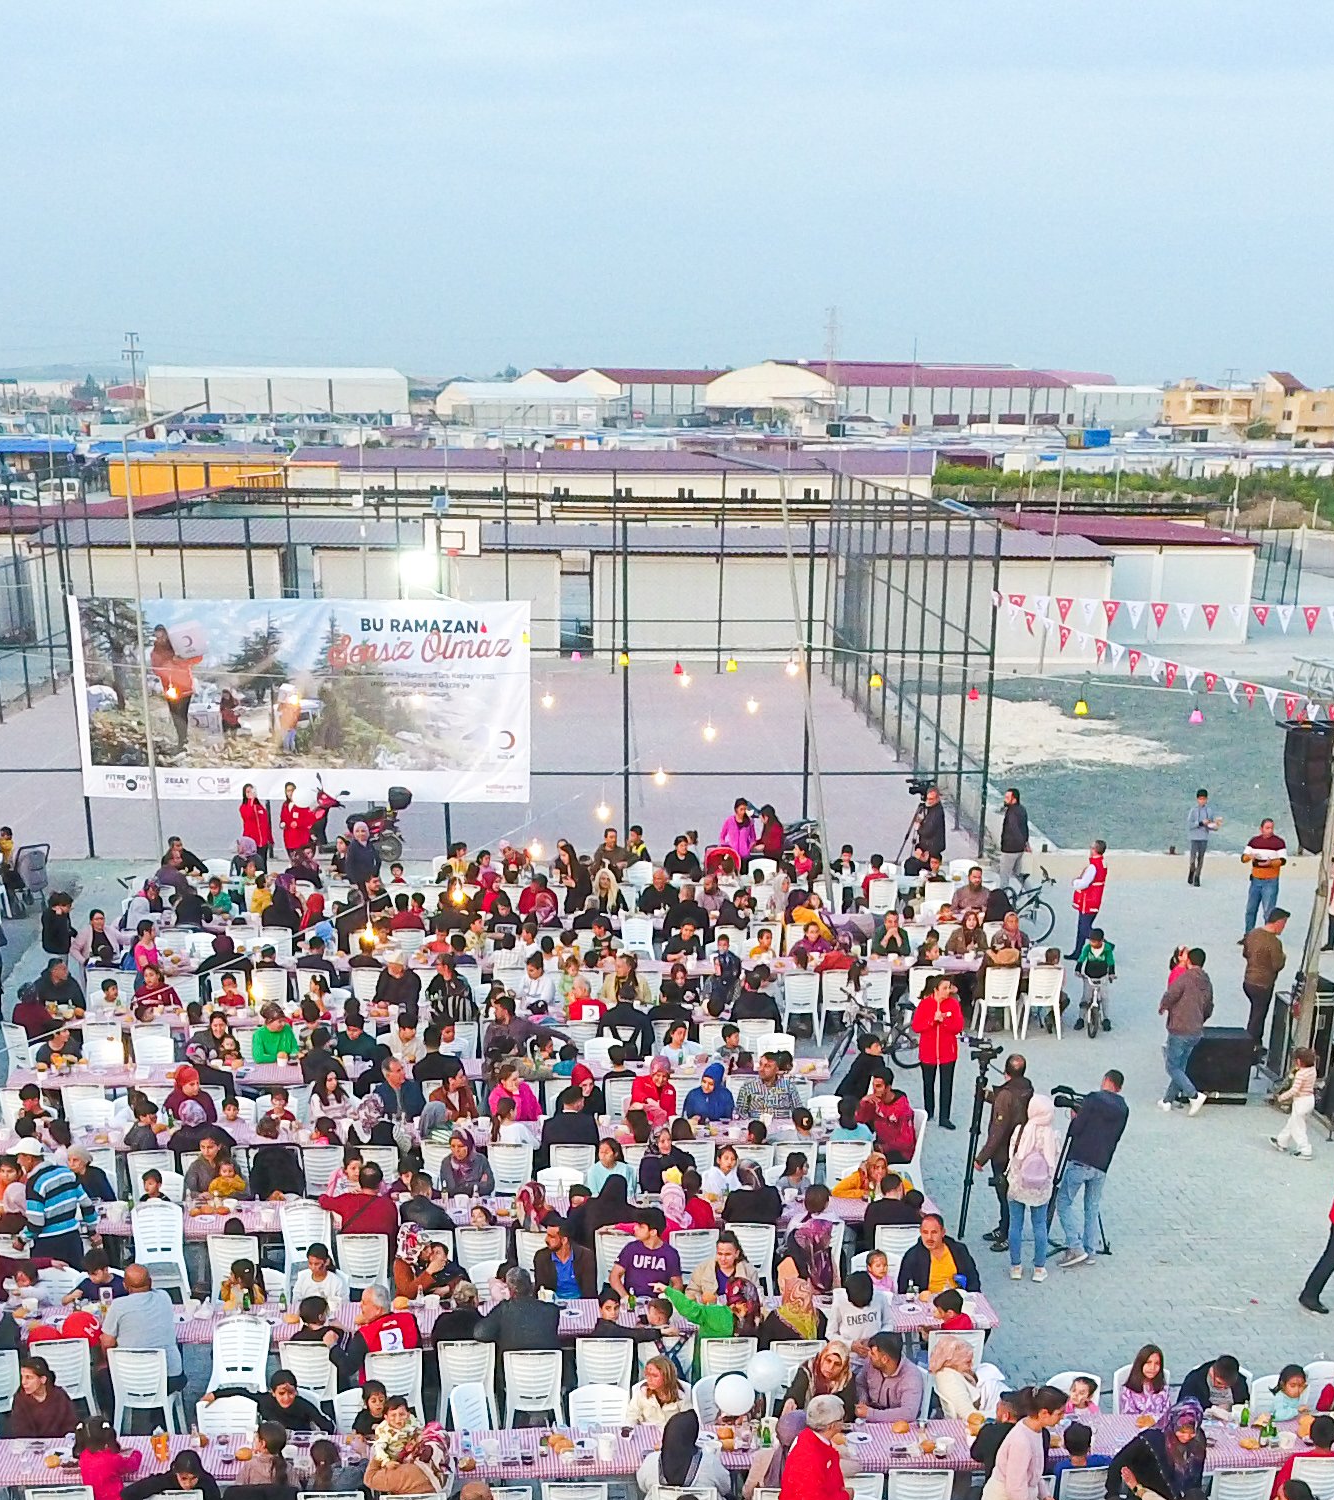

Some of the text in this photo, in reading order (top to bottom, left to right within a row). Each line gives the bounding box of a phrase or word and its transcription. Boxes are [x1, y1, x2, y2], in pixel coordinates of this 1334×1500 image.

[360, 618, 478, 633] BU RAMAZAN
[327, 630, 512, 669] Sensiz Olmaz
[632, 1254, 667, 1271] UFIA
[846, 1311, 878, 1326] ENERGY
